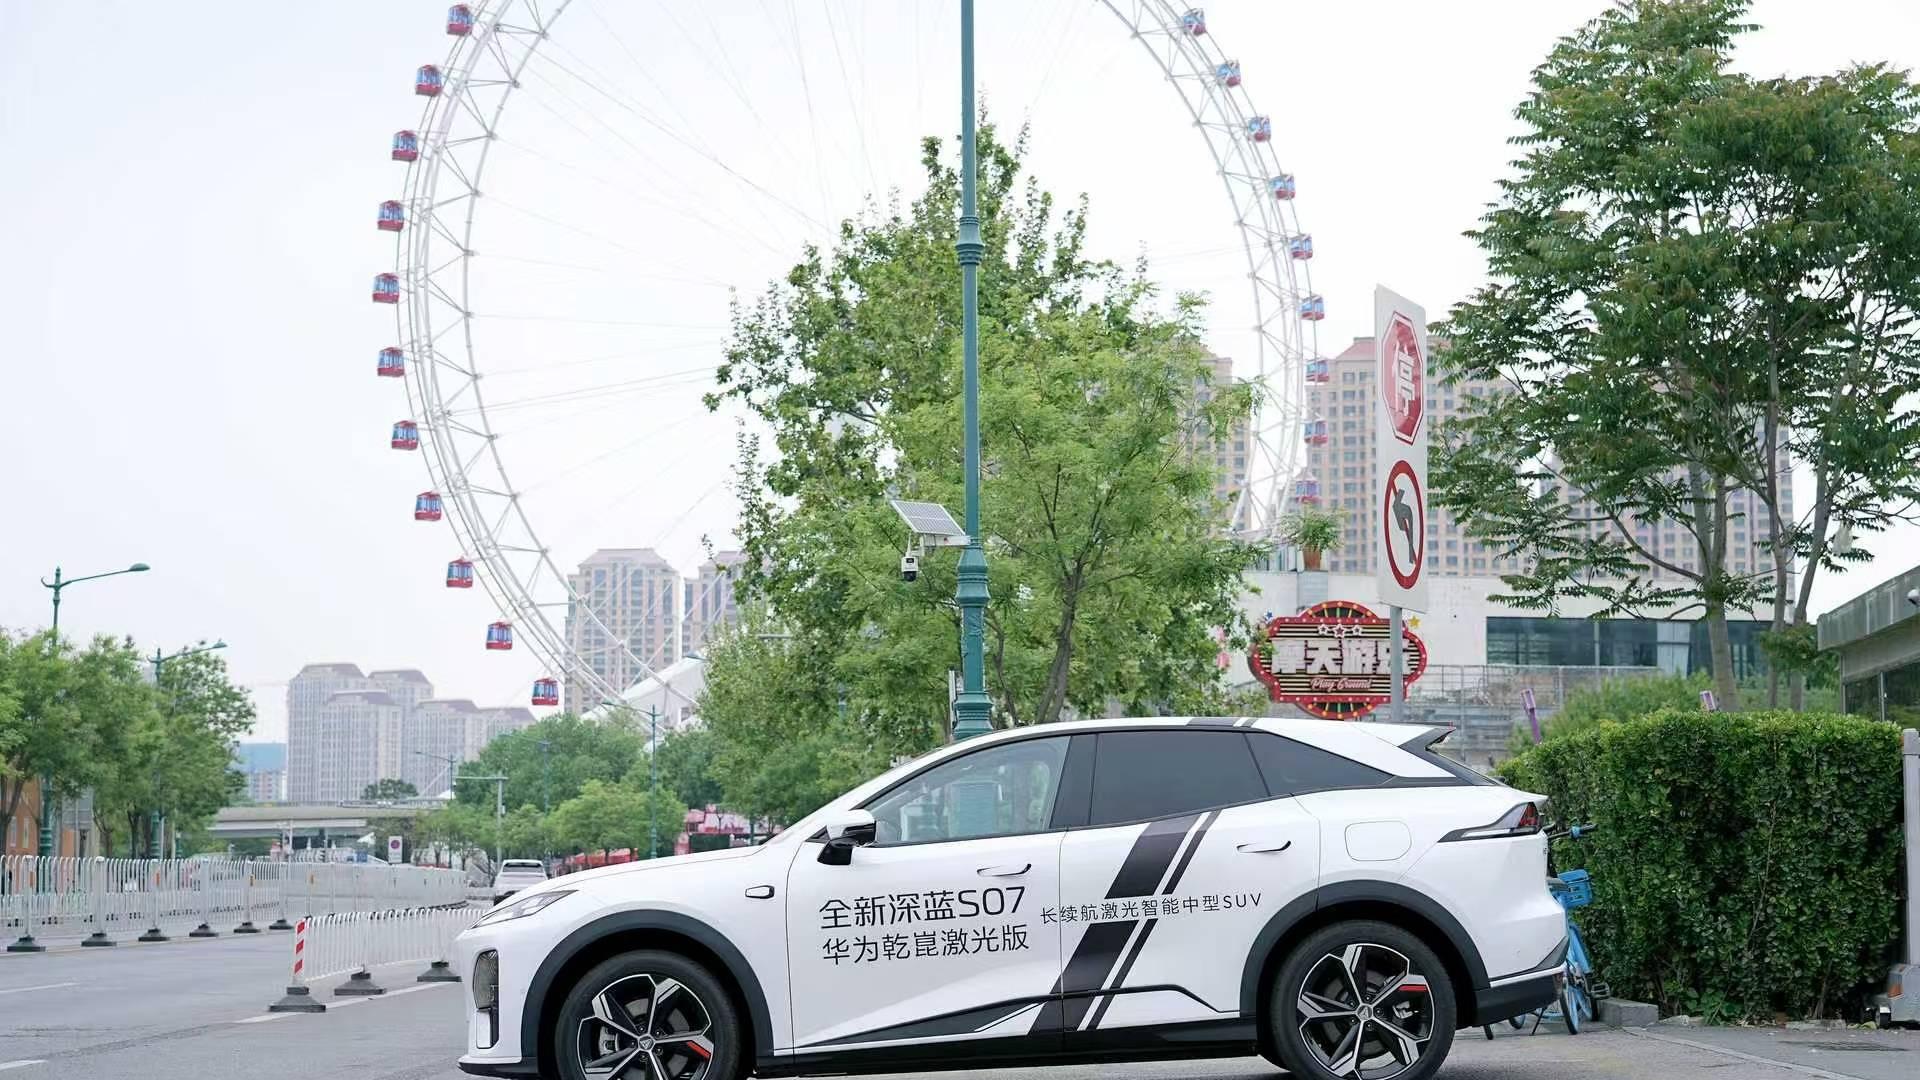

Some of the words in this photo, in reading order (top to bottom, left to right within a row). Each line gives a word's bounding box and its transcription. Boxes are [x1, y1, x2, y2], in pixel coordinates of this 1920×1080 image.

[1392, 340, 1415, 417] 停
[1311, 677, 1335, 692] Play
[1337, 677, 1371, 690] Ground
[818, 886, 1026, 930] 全新深蓝S07
[1039, 892, 1263, 925] 长续航激光智能中型SUV
[822, 924, 1030, 966] 华为乾崑激光版
